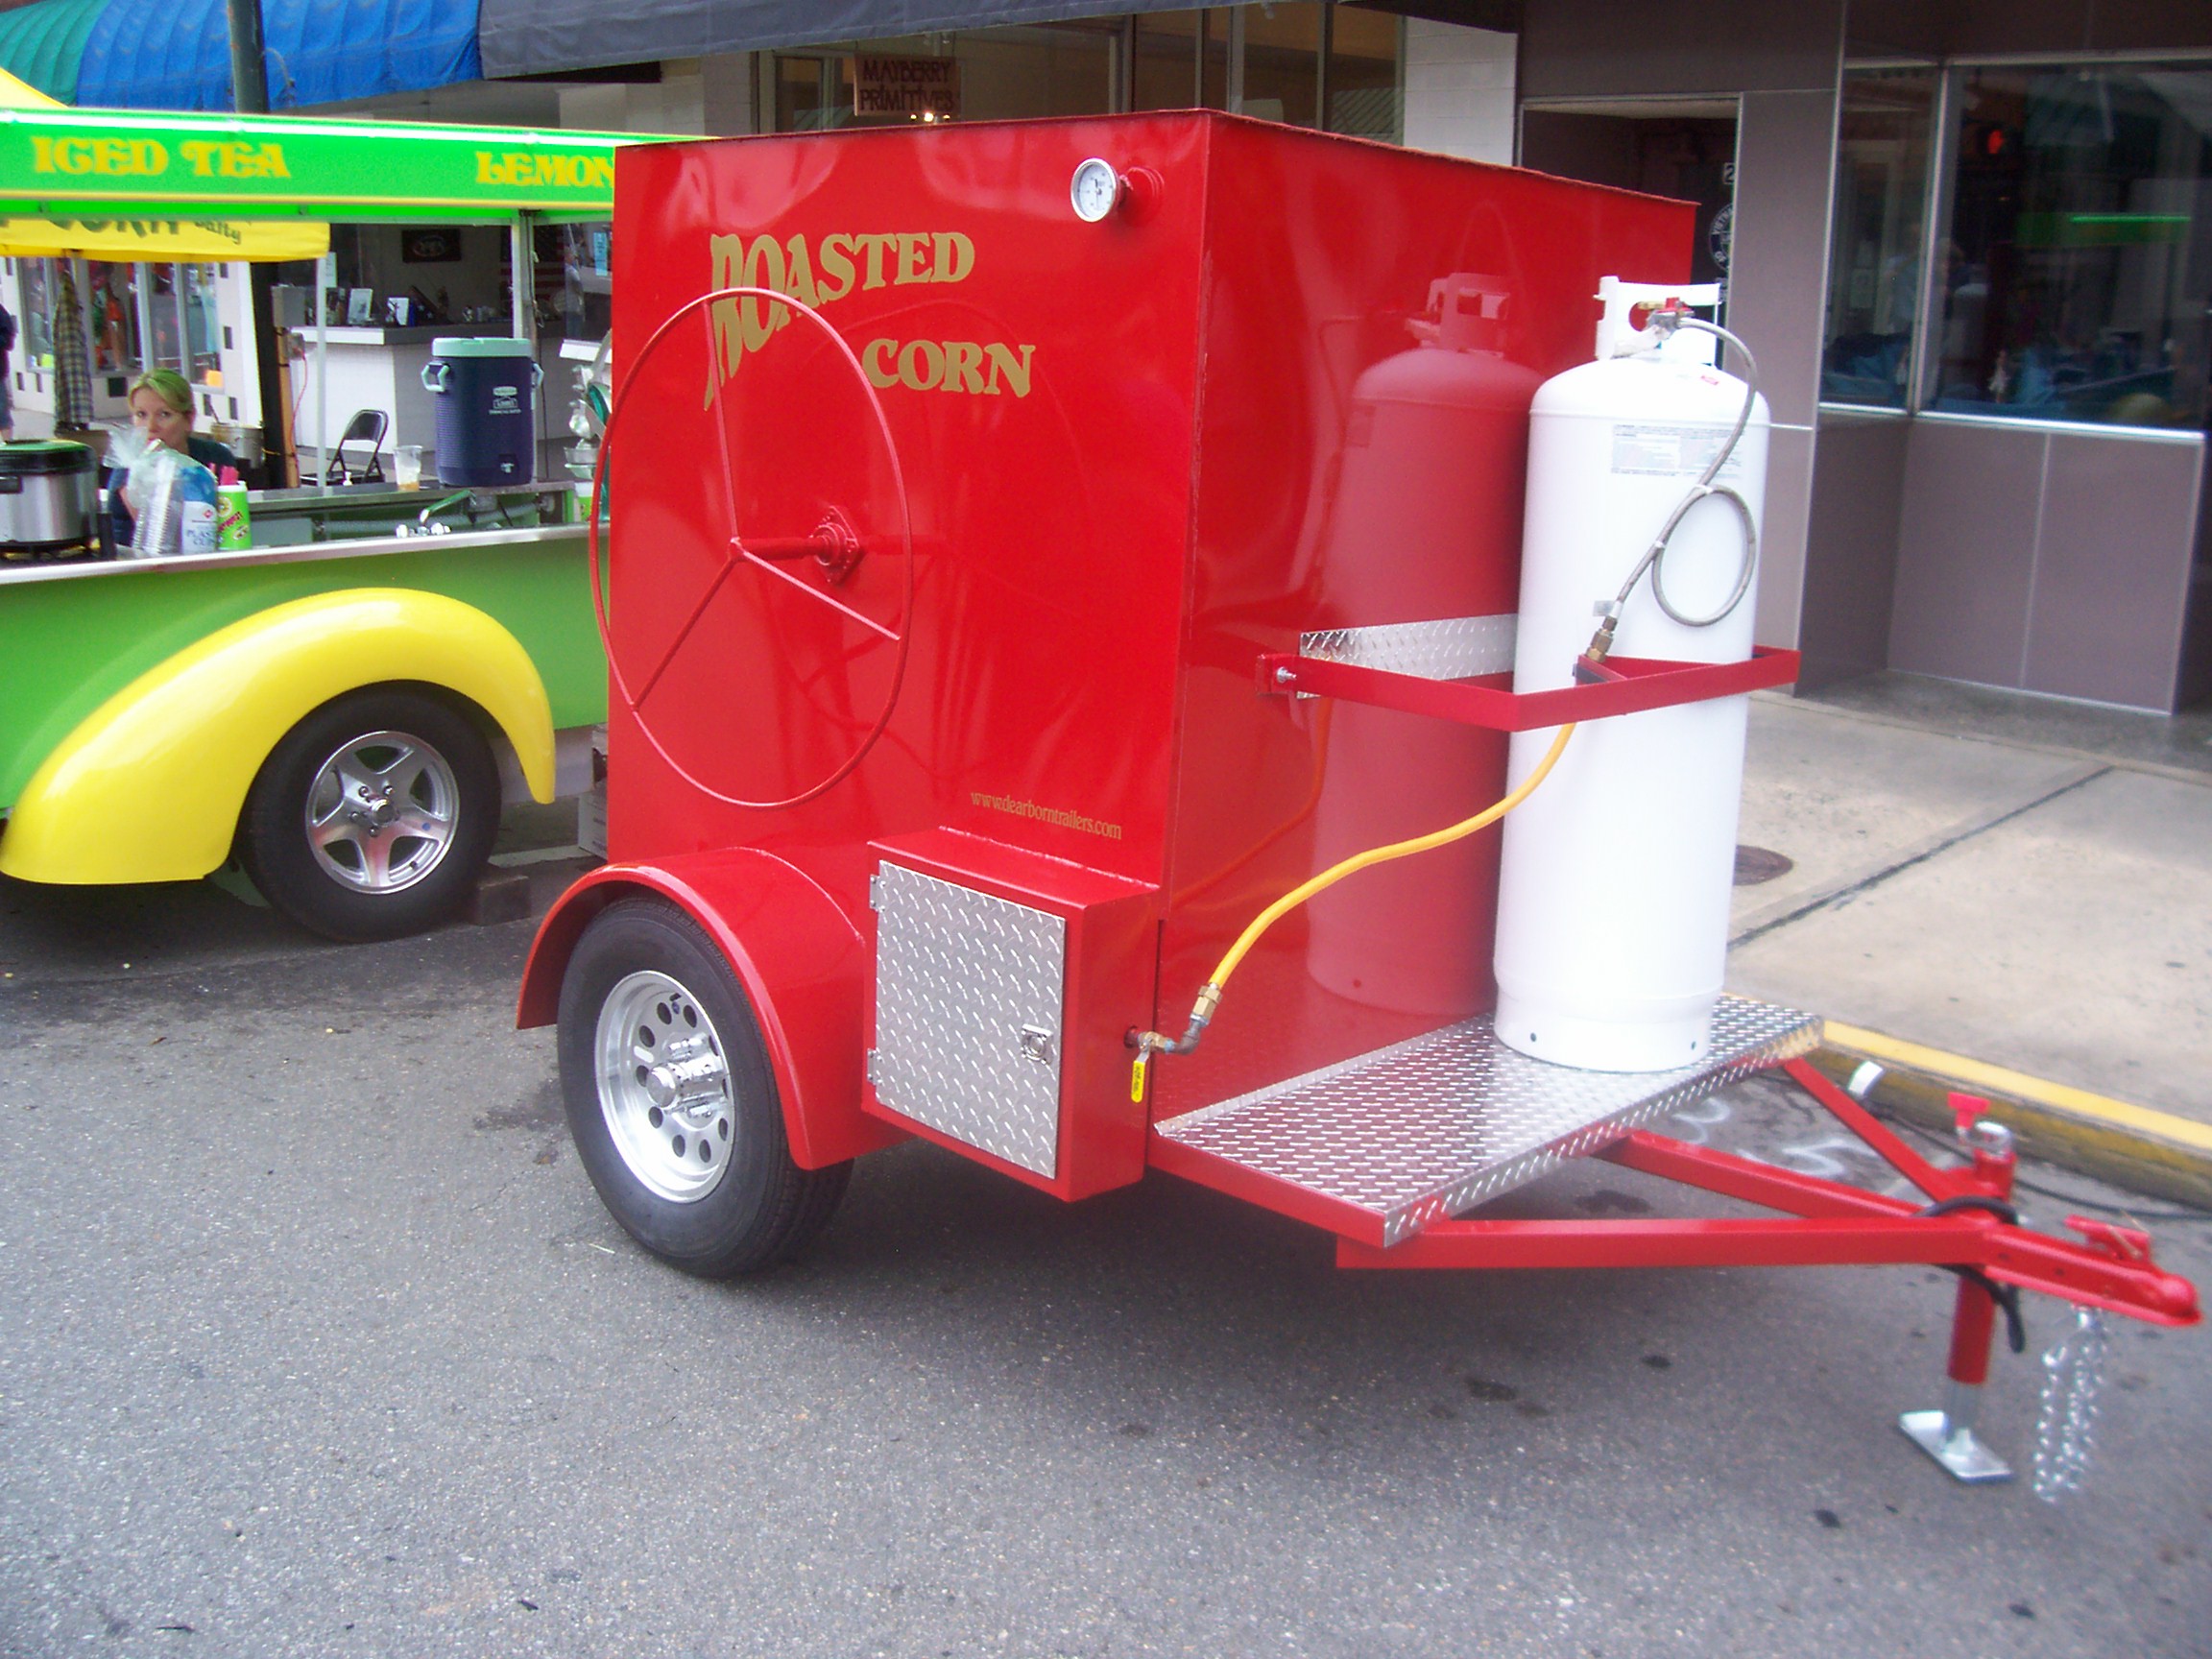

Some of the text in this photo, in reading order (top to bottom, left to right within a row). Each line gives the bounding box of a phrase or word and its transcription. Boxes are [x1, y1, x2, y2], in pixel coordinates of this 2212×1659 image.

[863, 60, 950, 83] MAYBERRY
[859, 84, 954, 111] PRIMITIVES
[31, 134, 291, 178] ICED TEA
[475, 151, 615, 187] LEMON
[195, 220, 241, 245] alty
[704, 231, 975, 412] ROASTED
[861, 338, 1037, 398] CORN
[970, 792, 1122, 840] www.dearborntrailers.com
